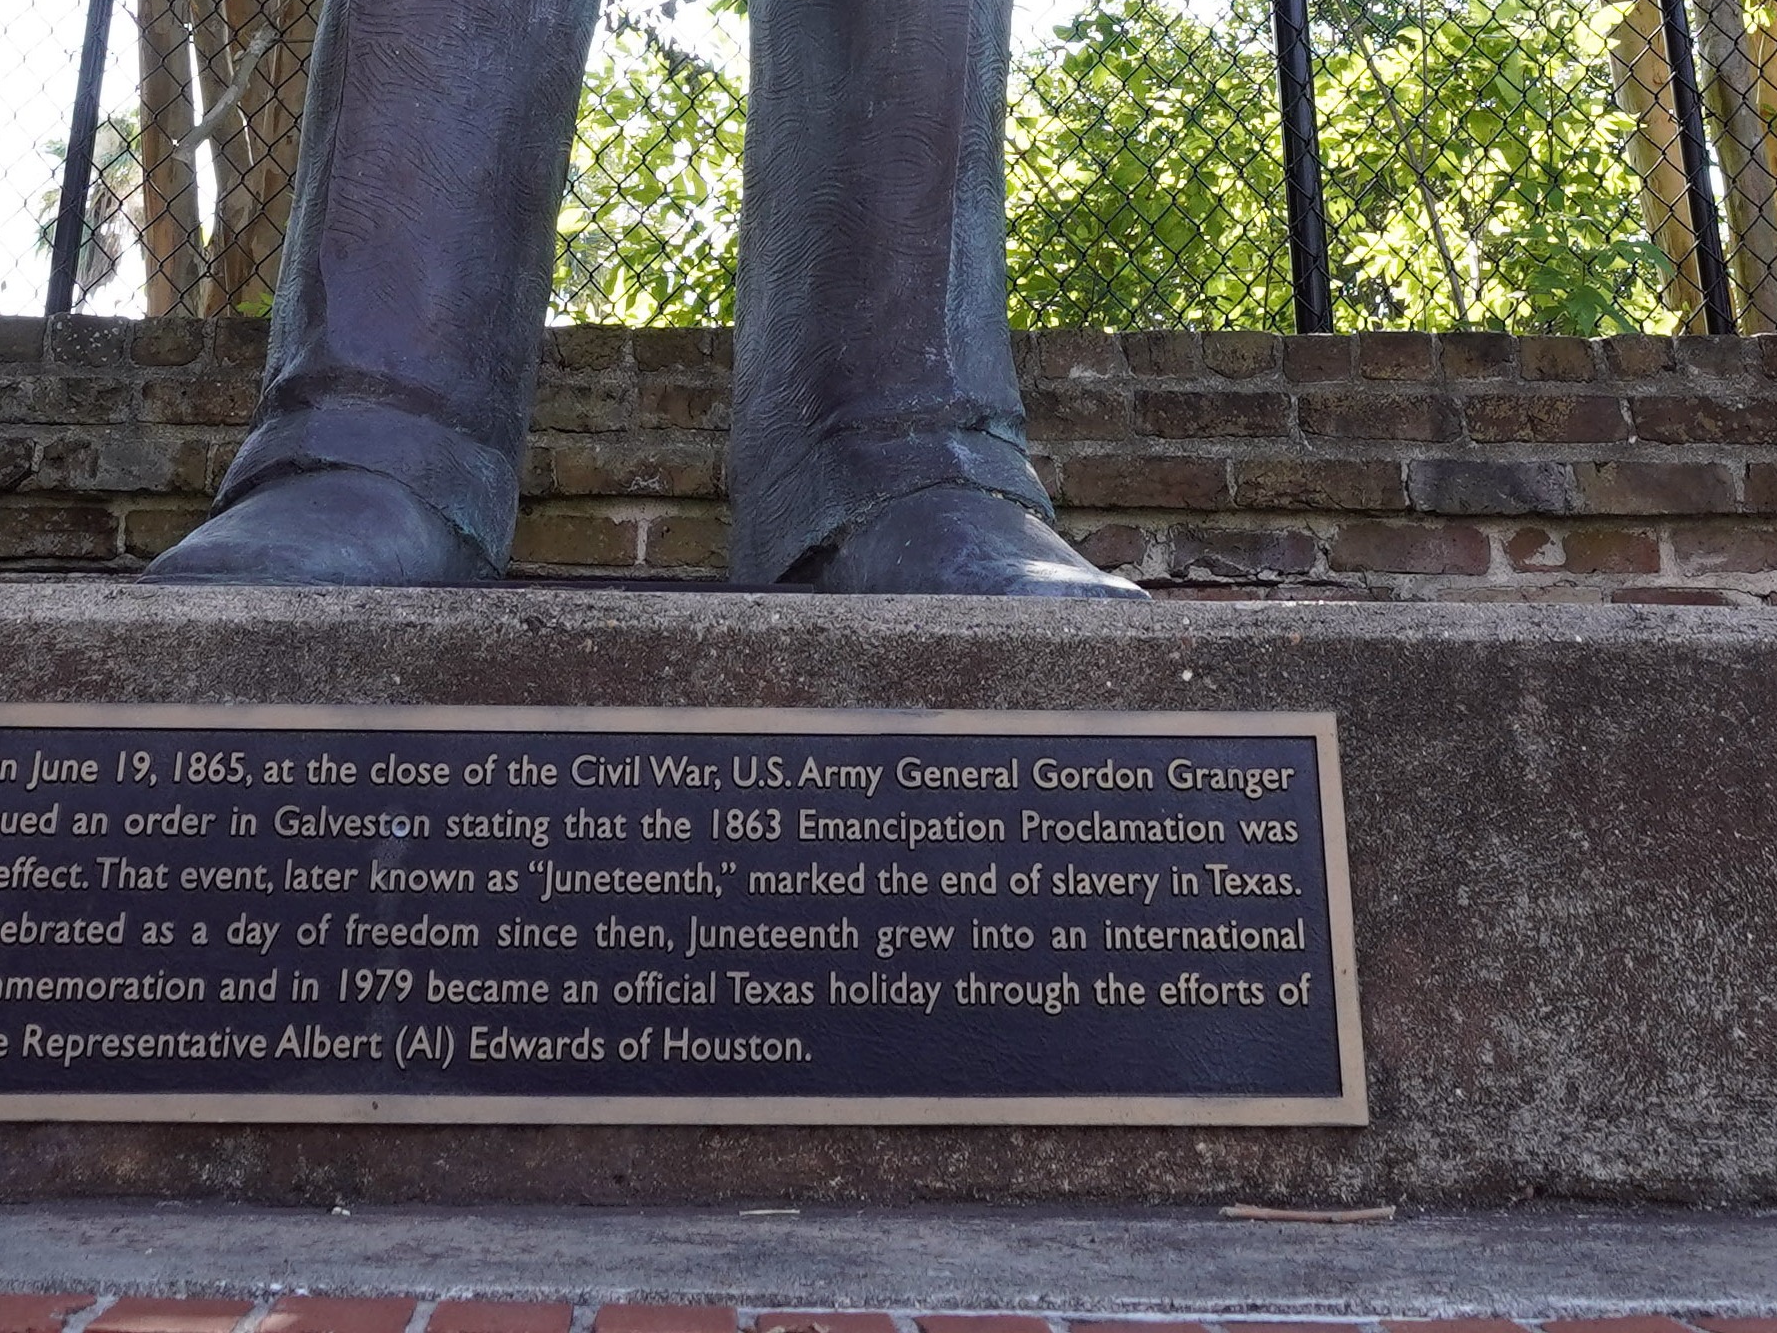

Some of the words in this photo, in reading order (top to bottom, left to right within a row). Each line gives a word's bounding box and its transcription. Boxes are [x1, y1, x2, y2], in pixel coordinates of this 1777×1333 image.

[25, 750, 99, 791] June
[115, 750, 157, 787] 19,
[172, 751, 253, 788] 1865,
[262, 758, 295, 784] at
[305, 752, 357, 785] the
[369, 753, 450, 786] close
[462, 753, 498, 786] of
[506, 754, 558, 787] the
[570, 754, 641, 787] Civil
[648, 755, 722, 792] War,
[732, 755, 792, 788] U.S.
[796, 756, 884, 798] Army
[895, 756, 1019, 790] General
[1031, 757, 1154, 790] Gordon
[1166, 758, 1295, 800] Granger
[71, 812, 109, 836] an
[123, 803, 217, 836] order
[229, 806, 257, 837] in
[273, 804, 430, 839] Galveston
[445, 808, 551, 849] stating
[562, 807, 627, 840] that
[639, 807, 692, 841] the
[711, 808, 782, 841] 1863
[798, 808, 1005, 851] Emancipation
[1020, 809, 1225, 843] Proclamation
[1238, 820, 1299, 843] was
[95, 856, 169, 890] That
[179, 864, 274, 895] event,
[283, 858, 359, 892] later
[369, 859, 475, 893] known
[486, 869, 519, 893] as
[527, 859, 737, 903] “Juneteenth,”
[748, 861, 865, 895] marked
[876, 862, 929, 895] the
[939, 862, 997, 895] end
[1008, 862, 1043, 896] of
[1051, 863, 1160, 906] slavery
[1170, 865, 1199, 896] in
[1203, 863, 1302, 897] Texas.
[140, 921, 174, 945] as
[190, 921, 209, 946] a
[225, 912, 280, 956] day
[295, 912, 332, 946] of
[344, 913, 479, 948] freedom
[496, 916, 578, 948] since
[594, 914, 674, 953] then,
[684, 915, 859, 959] Juneteenth
[875, 925, 955, 959] grew
[971, 918, 1035, 950] into
[1050, 926, 1087, 951] an
[1104, 917, 1305, 951] international
[218, 967, 278, 1002] and
[291, 970, 319, 1002] in
[338, 968, 414, 1003] 1979
[426, 969, 549, 1004] became
[561, 980, 599, 1004] an
[612, 970, 716, 1005] official
[725, 971, 815, 1006] Texas
[829, 971, 942, 1015] holiday
[953, 971, 1080, 1016] through
[1092, 971, 1146, 1006] the
[1158, 972, 1265, 1006] efforts
[1277, 971, 1312, 1007] of
[21, 1023, 267, 1068] Representative
[273, 1024, 383, 1060] Albert
[394, 1025, 455, 1071] (Al)
[468, 1026, 605, 1062] Edwards
[617, 1026, 653, 1062] of
[662, 1026, 812, 1063] Houston.
